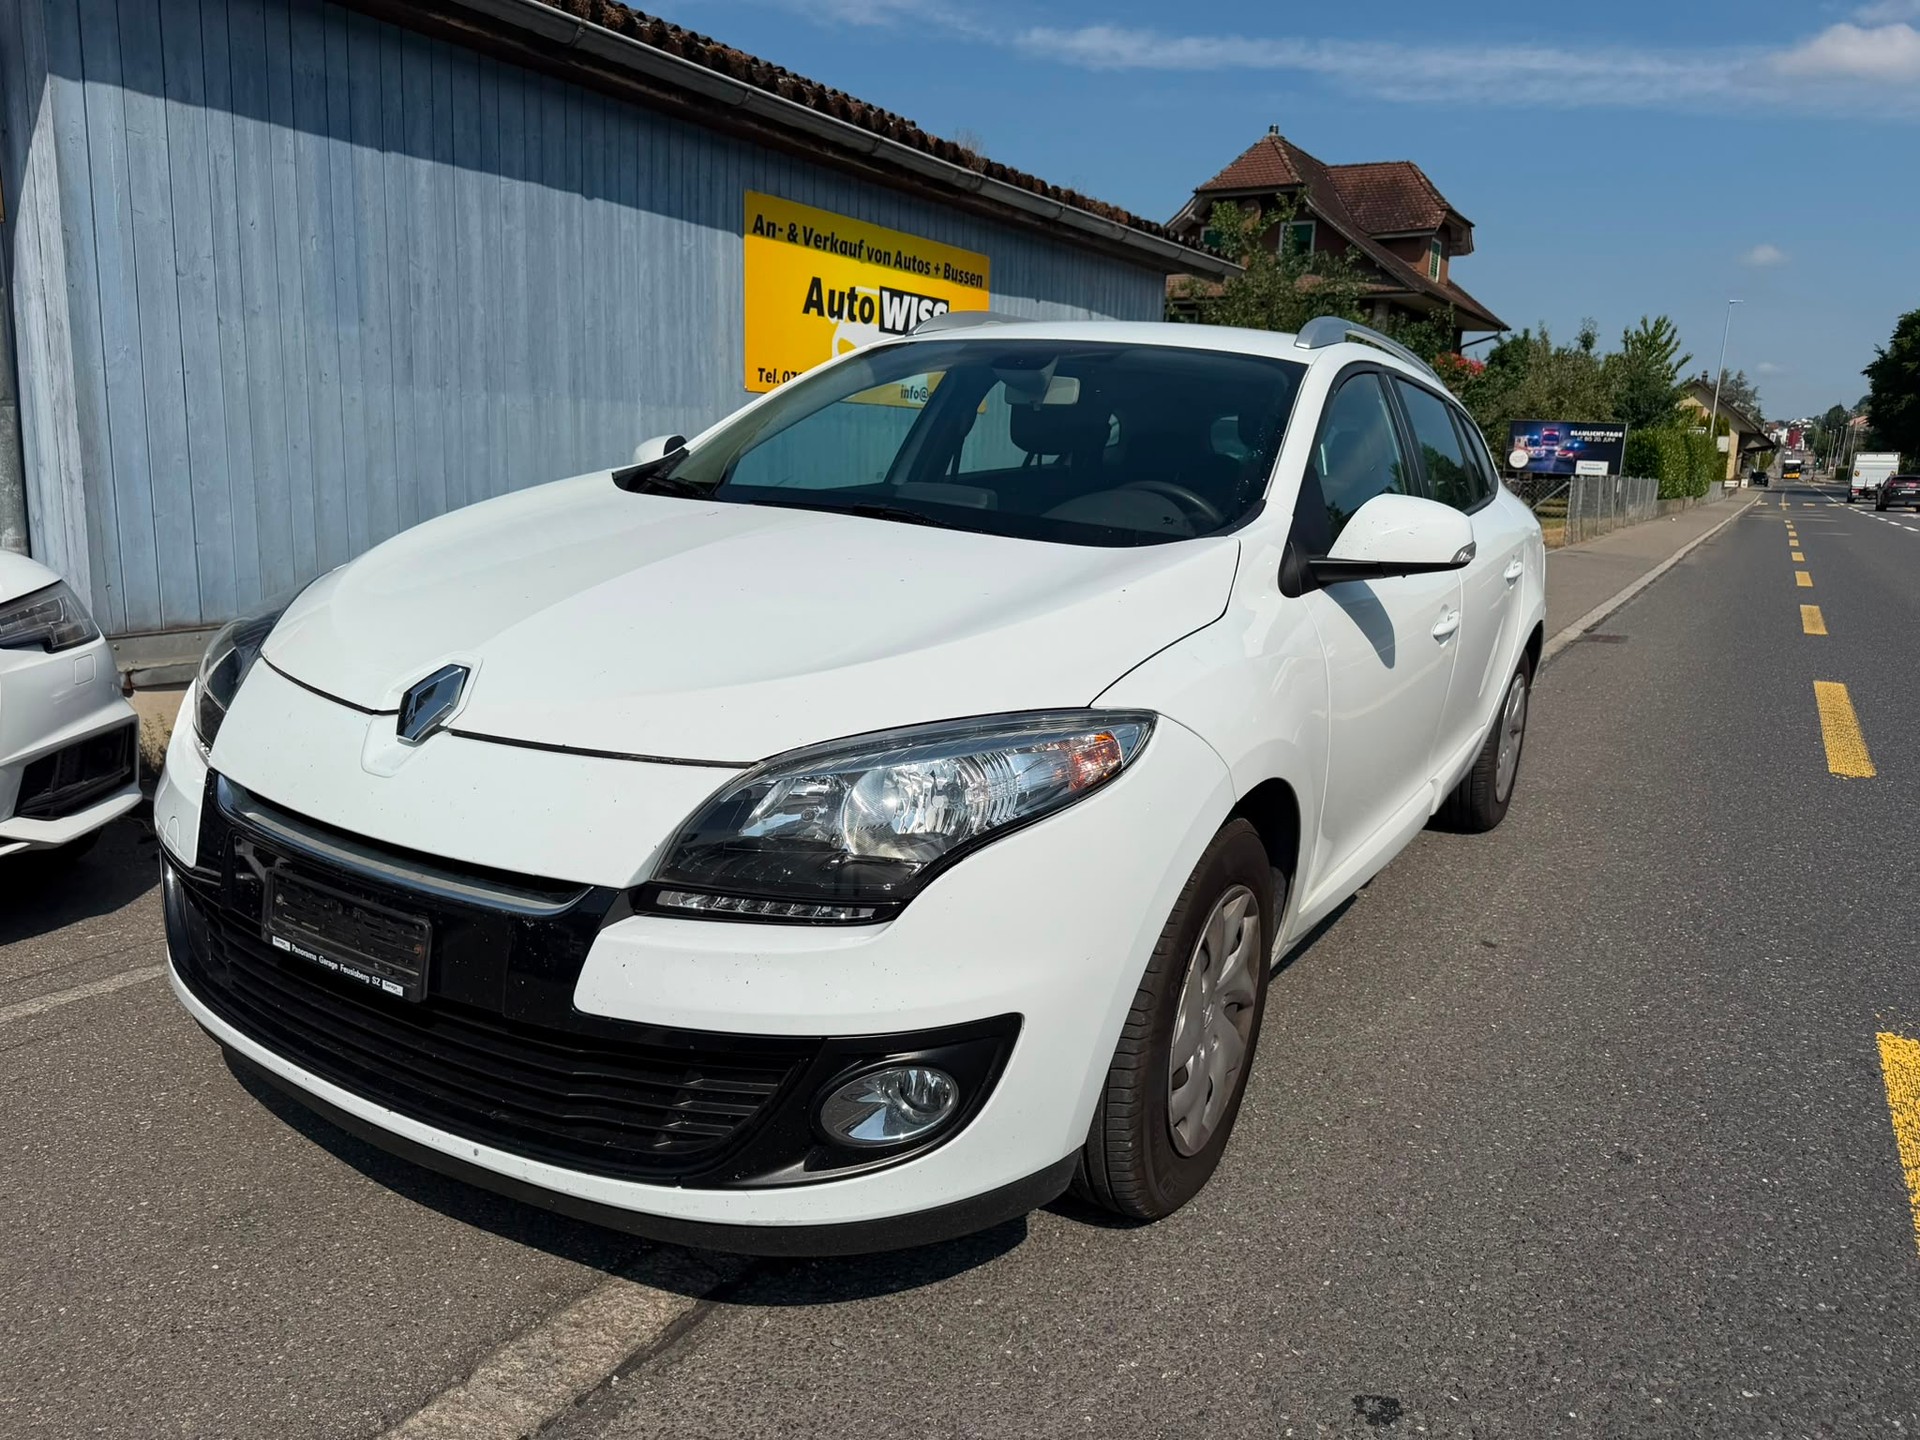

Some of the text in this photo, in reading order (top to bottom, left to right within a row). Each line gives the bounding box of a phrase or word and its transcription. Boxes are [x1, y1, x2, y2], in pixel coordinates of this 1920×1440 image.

[752, 214, 983, 288] An- & Verkauf von Autos + Bussen
[802, 276, 875, 324] Auto
[758, 367, 780, 384] Tel.
[291, 943, 317, 961] Panorama
[318, 955, 338, 970] Garage
[371, 976, 381, 986] SZ
